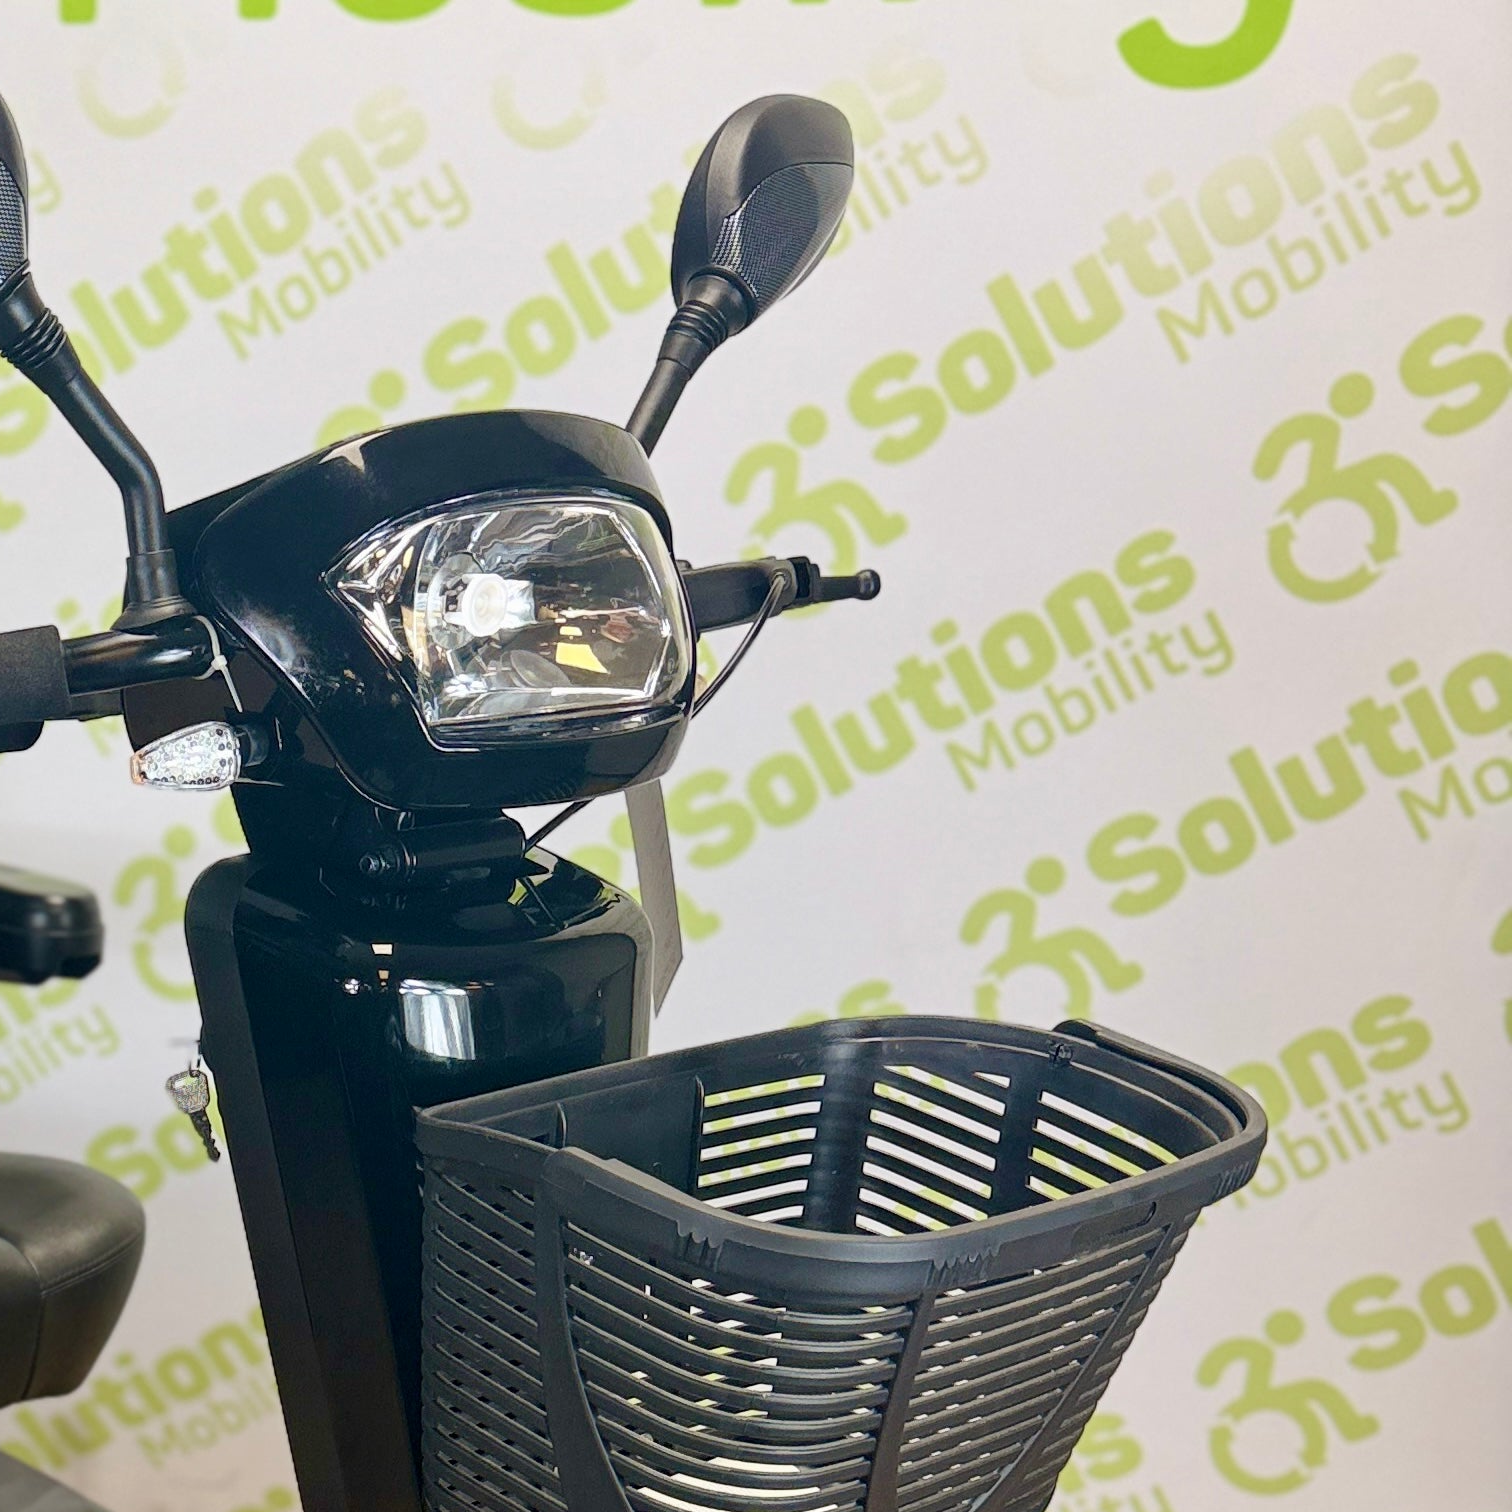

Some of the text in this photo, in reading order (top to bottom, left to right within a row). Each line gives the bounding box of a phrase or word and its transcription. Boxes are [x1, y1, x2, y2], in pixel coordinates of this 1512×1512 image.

[215, 162, 473, 361] Mobility
[846, 52, 1441, 466] Solutions
[1155, 140, 1482, 365] Mobility
[668, 530, 1198, 870] Solutions
[945, 610, 1236, 793] Mobility
[1196, 1070, 1472, 1225] obility
[0, 1308, 266, 1472] lution
